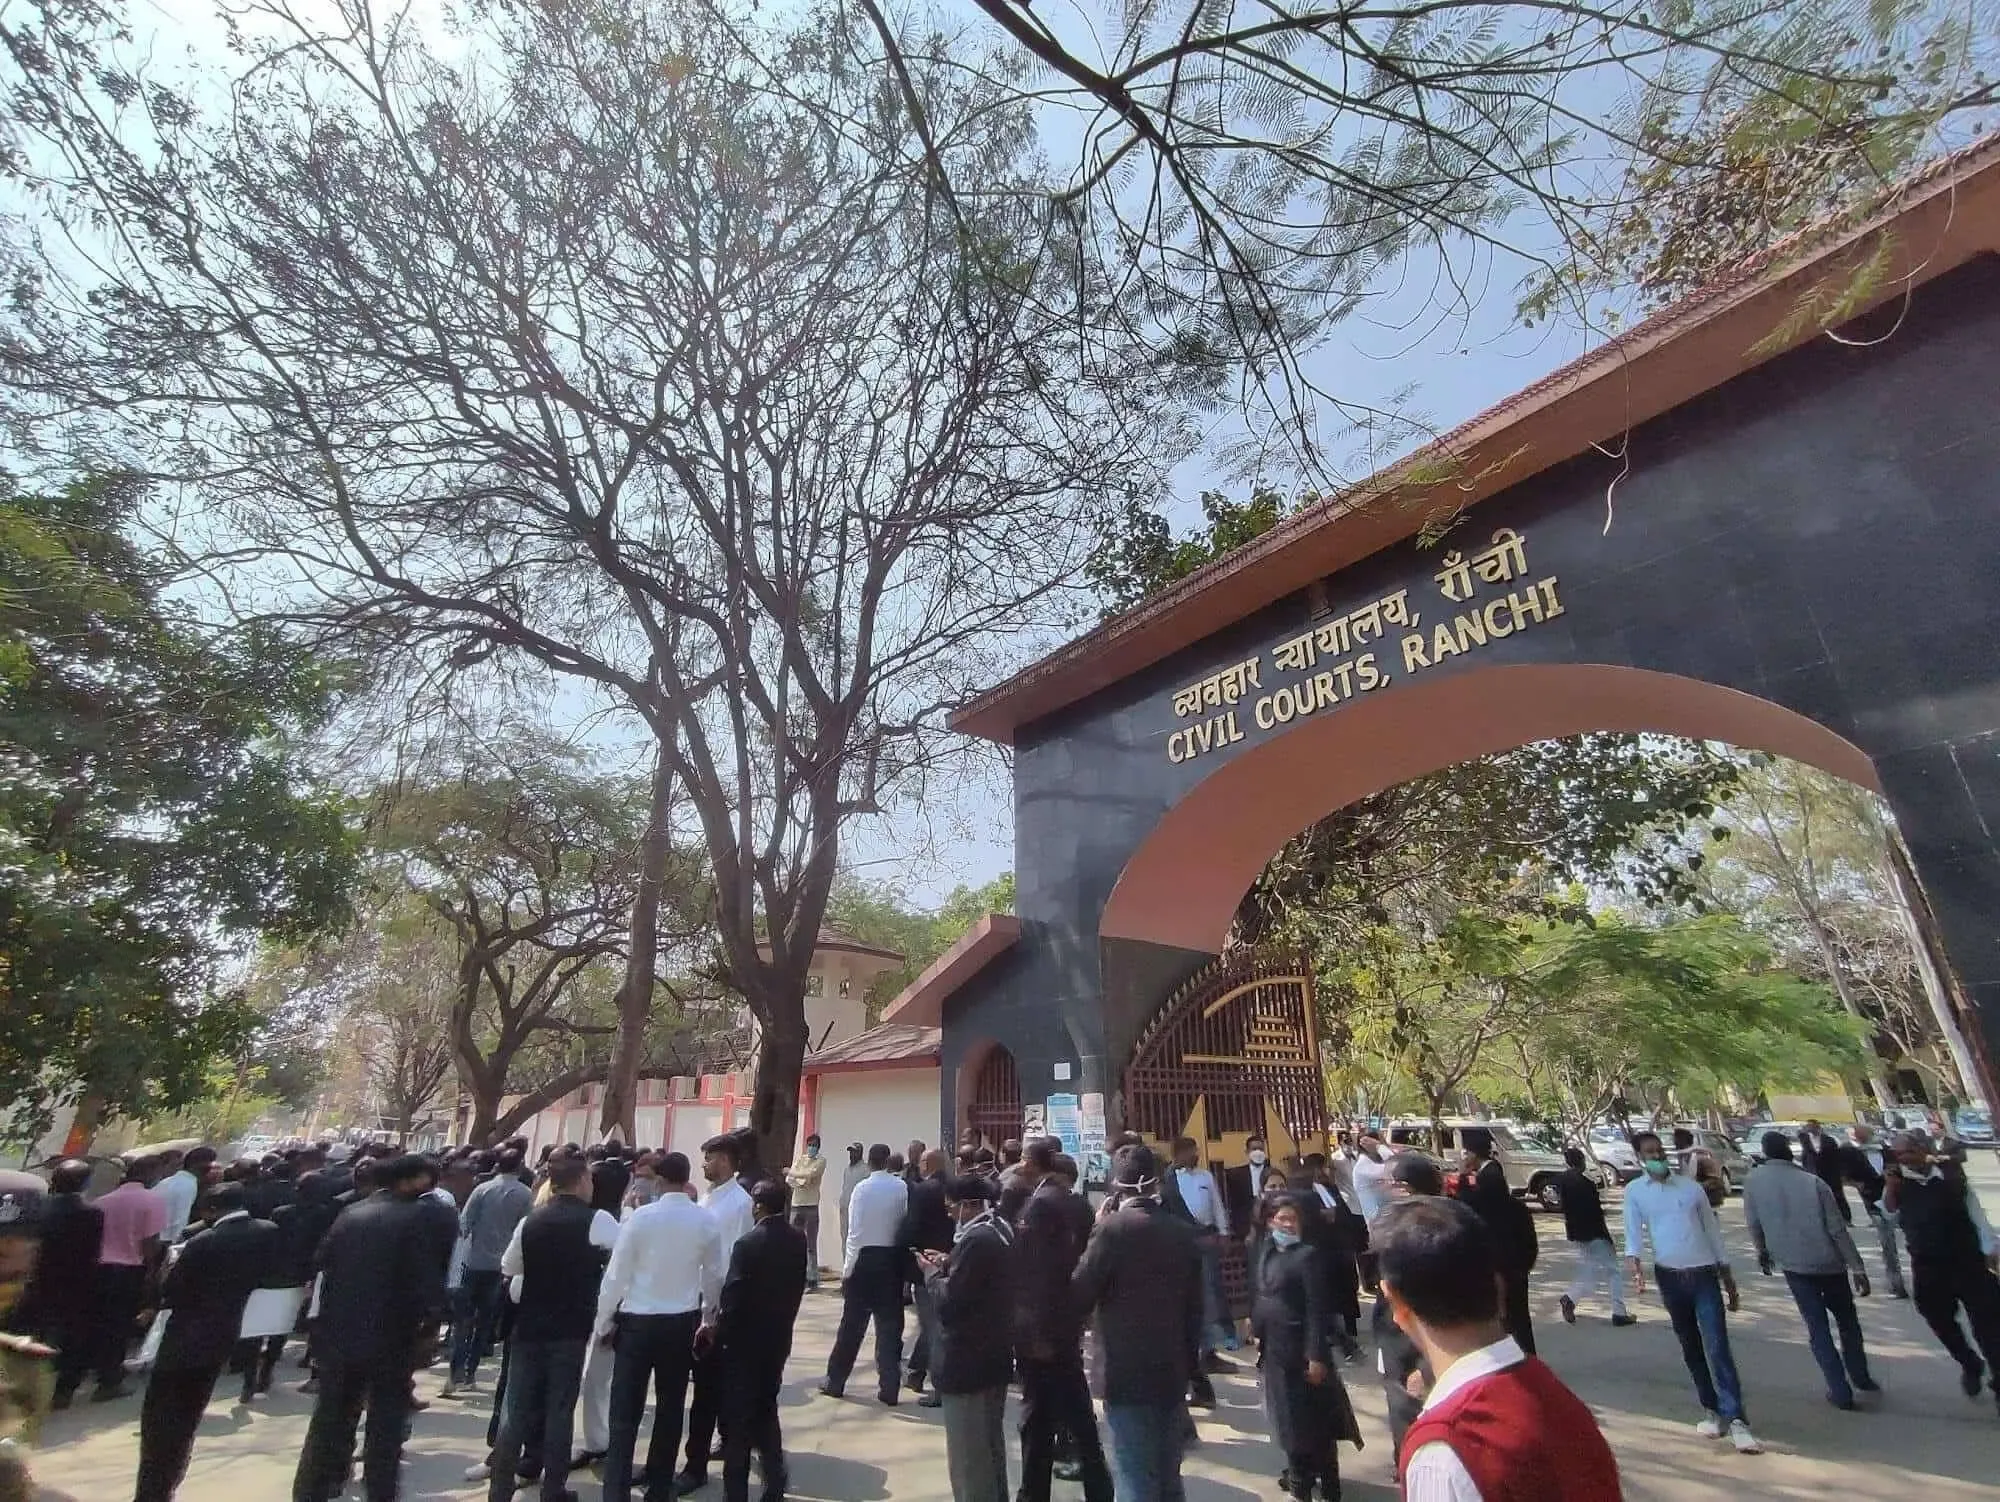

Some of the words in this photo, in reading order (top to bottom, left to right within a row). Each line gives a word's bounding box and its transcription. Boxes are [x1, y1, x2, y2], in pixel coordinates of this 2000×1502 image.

[1168, 711, 1245, 764] CIVIL
[1255, 654, 1391, 730] COURTS,
[1401, 576, 1566, 673] RANCHI
[1173, 656, 1263, 718] व्यवहार
[1272, 590, 1421, 672] न्यायालय,
[1434, 528, 1529, 602] राँची
